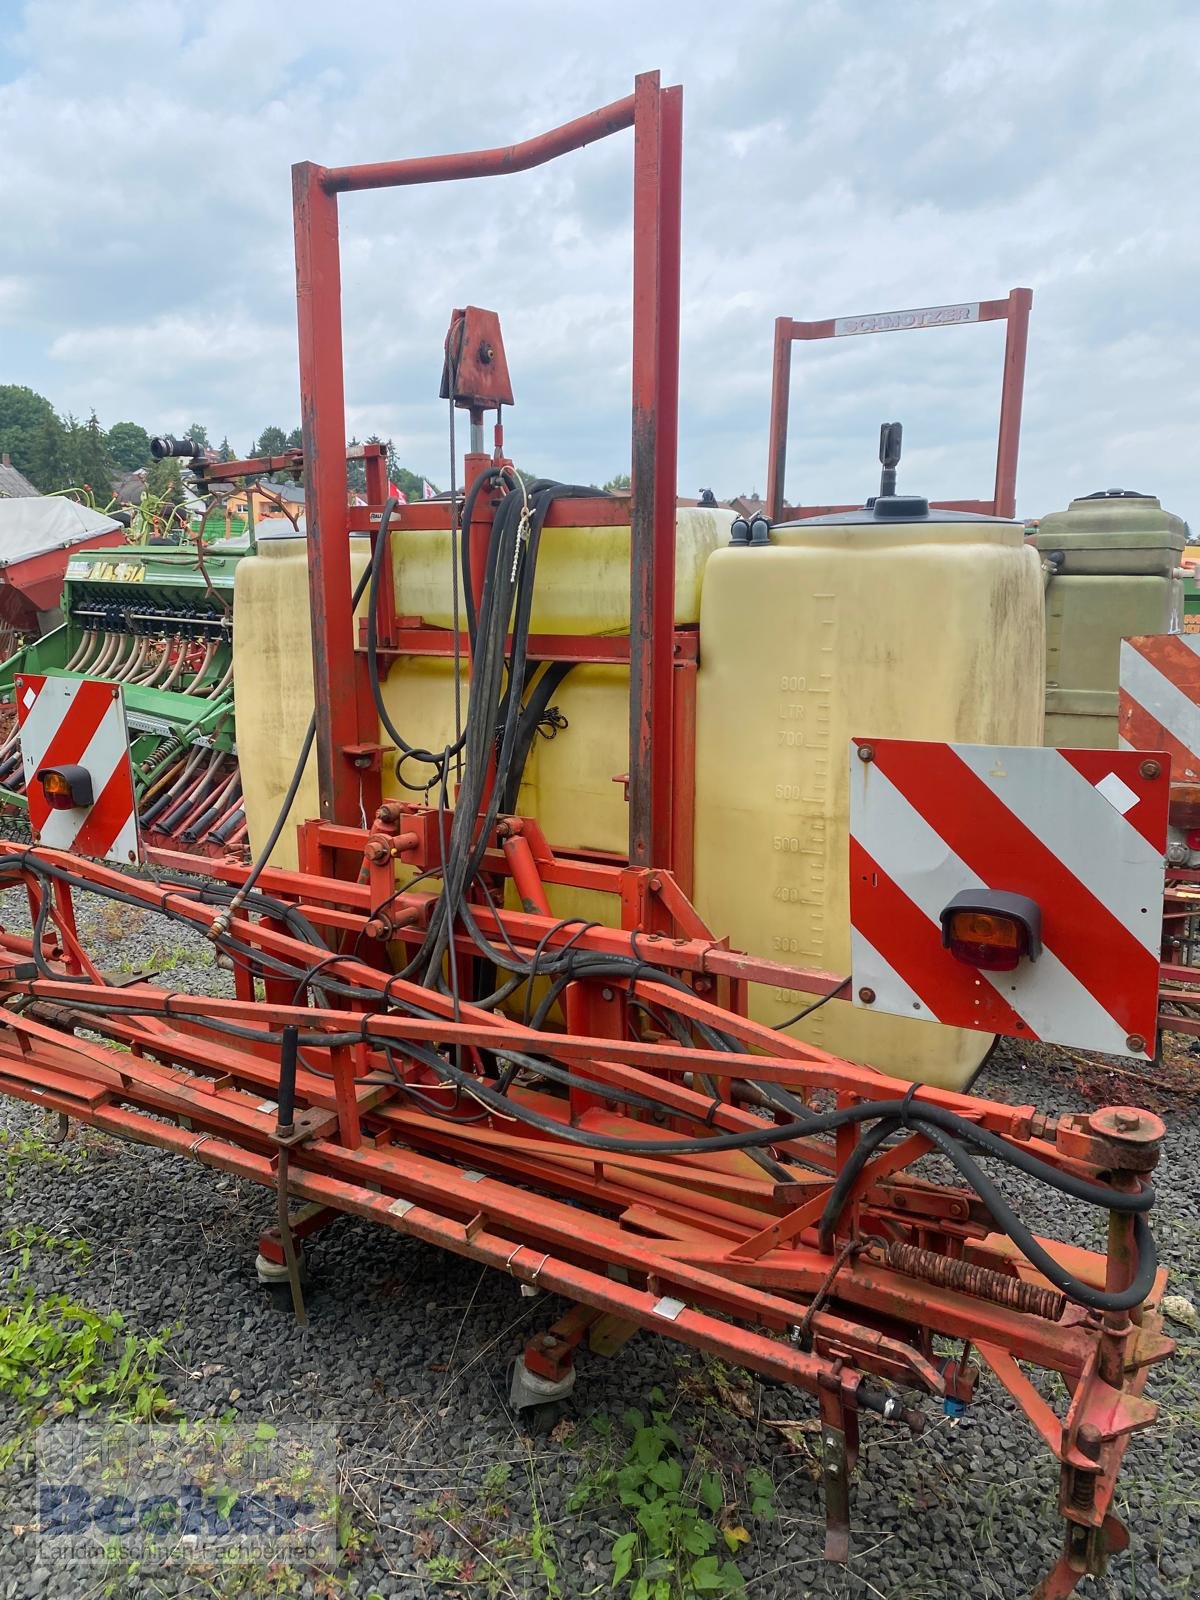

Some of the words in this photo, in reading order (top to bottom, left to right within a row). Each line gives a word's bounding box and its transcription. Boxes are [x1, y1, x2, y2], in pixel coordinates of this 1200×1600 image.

[842, 307, 970, 333] SCHMOTZER
[779, 675, 807, 690] 800
[779, 704, 805, 720] LTR
[777, 731, 804, 747] 700
[775, 784, 800, 800] 600
[773, 836, 799, 851] 500
[774, 887, 799, 902] 400
[773, 937, 798, 952] 300
[775, 988, 799, 1004] 200
